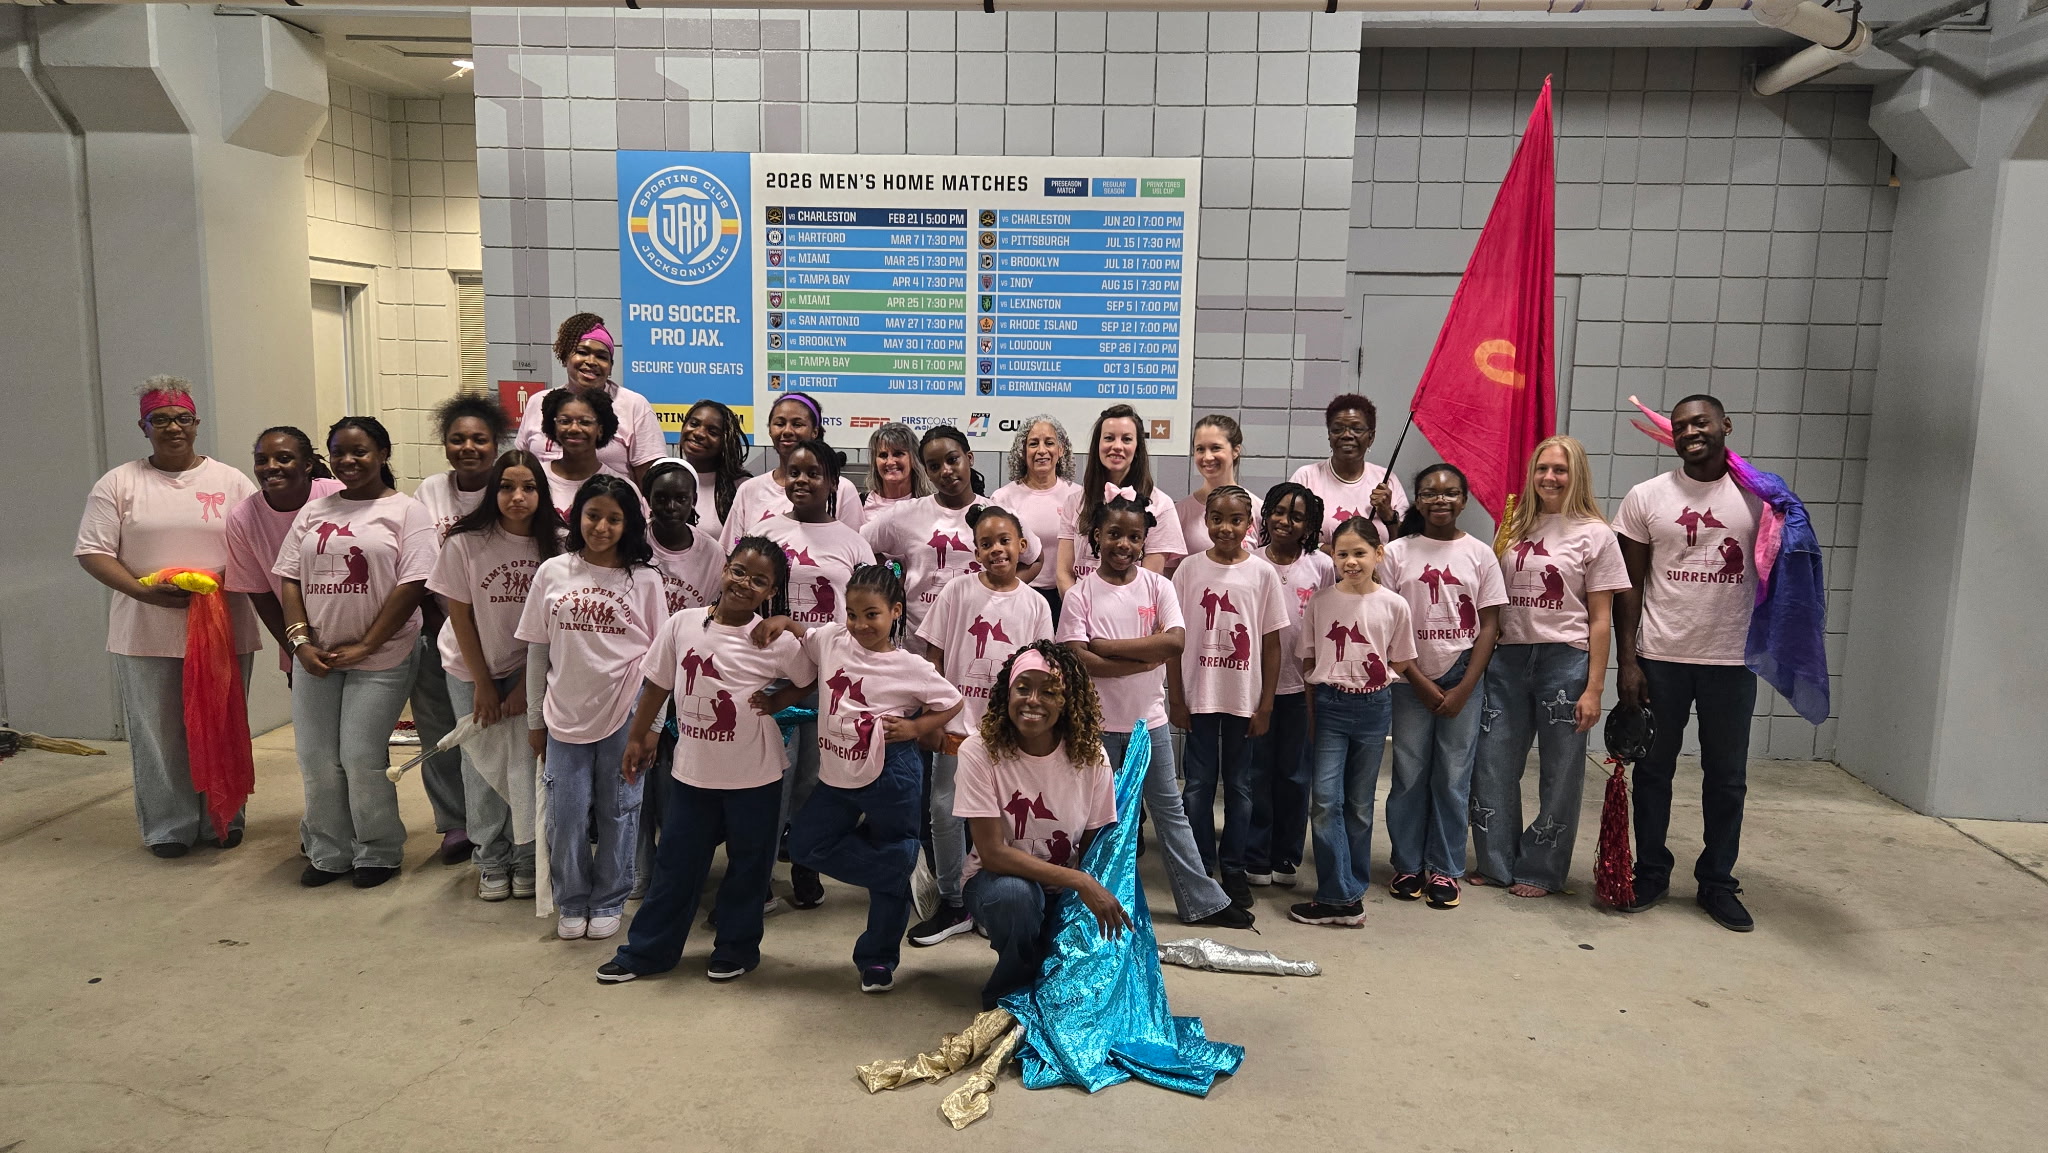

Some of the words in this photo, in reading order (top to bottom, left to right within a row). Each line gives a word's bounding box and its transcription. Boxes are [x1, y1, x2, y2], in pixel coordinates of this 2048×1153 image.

[766, 172, 812, 189] 2026
[820, 173, 876, 190] MEN'S
[883, 174, 935, 190] HOME
[942, 175, 1028, 191] MATCHES
[640, 174, 698, 207] SPORTING
[703, 181, 729, 209] CLUB
[1103, 187, 1125, 195] SEASON
[797, 210, 856, 222] CHARLESTON
[888, 212, 905, 223] FEB
[907, 213, 918, 224] 21
[925, 213, 947, 224] 5:00
[949, 213, 964, 224] PM
[1011, 213, 1070, 225] CHARLESTON
[1102, 215, 1120, 226] JUN
[1122, 215, 1135, 226] 20
[1143, 215, 1164, 226] 7:00
[1166, 216, 1181, 226] PM
[662, 202, 707, 255] JAX
[798, 231, 845, 243] HARTFORD
[890, 234, 911, 245] MAR
[913, 234, 919, 245] 7
[926, 234, 946, 245] 7:30
[949, 234, 964, 245] PM
[1011, 234, 1069, 246] PITTSBURGH
[1105, 236, 1121, 247] JUL
[1123, 237, 1134, 248] 15
[1142, 237, 1163, 248] 7:30
[1165, 237, 1180, 248] PM
[641, 245, 729, 277] JACKSONVILLE
[798, 252, 830, 264] MIAMI
[884, 255, 905, 266] MAR
[907, 255, 919, 266] 25
[926, 255, 946, 266] 7:30
[948, 256, 963, 266] PM
[1010, 256, 1059, 267] BROOKLYN
[1104, 258, 1120, 268] JUL
[1122, 258, 1134, 269] 18
[1141, 258, 1162, 269] 7:00
[1164, 258, 1180, 269] PM
[798, 273, 830, 284] TAMPA
[832, 274, 850, 284] BAY
[892, 276, 910, 287] APR
[912, 276, 919, 287] 4
[926, 276, 946, 287] 7:30
[948, 277, 963, 288] PM
[1010, 277, 1033, 288] INDY
[1101, 279, 1120, 290] AUG
[1122, 279, 1133, 290] 15
[1141, 279, 1161, 290] 7:30
[1163, 279, 1179, 290] PM
[798, 294, 830, 305] MIAMI
[886, 296, 905, 307] APR
[907, 297, 918, 308] 25
[926, 297, 946, 308] 7:30
[948, 298, 963, 308] PM
[1010, 298, 1061, 309] LEXINGTON
[1106, 300, 1124, 311] SEP
[1126, 300, 1132, 311] 5
[1140, 300, 1160, 311] 7:00
[1163, 301, 1178, 311] PM
[629, 303, 664, 322] PRO
[668, 304, 741, 324] SOCCER.
[798, 314, 816, 325] SAN
[818, 315, 859, 326] ANTONIO
[885, 317, 905, 328] MAY
[907, 318, 918, 328] 27
[926, 318, 946, 329] 7:30
[948, 318, 963, 329] PM
[1009, 319, 1040, 329] RHODE
[1043, 319, 1077, 330] ISLAND
[1101, 321, 1119, 332] SEP
[1121, 321, 1132, 332] 12
[1139, 321, 1160, 332] 7:00
[1162, 322, 1177, 332] PM
[650, 327, 686, 346] PRO
[689, 328, 724, 347] JAX.
[798, 335, 846, 346] BROOKLYN
[883, 338, 903, 348] MAY
[905, 338, 918, 349] 30
[925, 338, 946, 349] 7:00
[948, 339, 962, 350] PM
[1009, 339, 1051, 350] LOUDOUN
[1099, 342, 1117, 352] SEP
[1118, 342, 1131, 353] 26
[1138, 342, 1159, 353] 7:00
[1161, 343, 1176, 353] PM
[631, 360, 674, 374] SECURE
[676, 361, 707, 374] YOUR
[709, 362, 744, 375] SEATS
[798, 356, 830, 366] TAMPA
[832, 356, 850, 367] BAY
[892, 358, 909, 369] JUN
[911, 359, 918, 369] 6
[925, 359, 945, 370] 7:00
[948, 360, 962, 370] PM
[1008, 360, 1061, 371] LOUISVILLE
[1103, 362, 1121, 373] OCT
[1123, 363, 1129, 373] 3
[1137, 363, 1158, 374] 5:00
[1160, 363, 1176, 374] PM
[799, 376, 838, 387] DETROIT
[887, 379, 904, 389] JUN
[907, 379, 918, 390] 13
[925, 379, 945, 390] 7:00
[947, 380, 962, 390] PM
[1008, 380, 1071, 392] BIRMINGHAM
[1097, 383, 1115, 393] OCT
[1117, 383, 1129, 394] 10
[1136, 384, 1158, 394] 5:00
[1160, 384, 1175, 394] PM
[850, 416, 891, 428] ESPN
[480, 563, 508, 590] KIM'S
[1666, 570, 1744, 584] SURRENDER
[490, 595, 527, 603] DANCE
[685, 583, 704, 604] DOO
[552, 590, 579, 616] KIM'S
[582, 587, 616, 599] OPEN
[792, 611, 835, 623] ENDER
[560, 622, 594, 632] DANCE
[595, 625, 627, 635] TEAM
